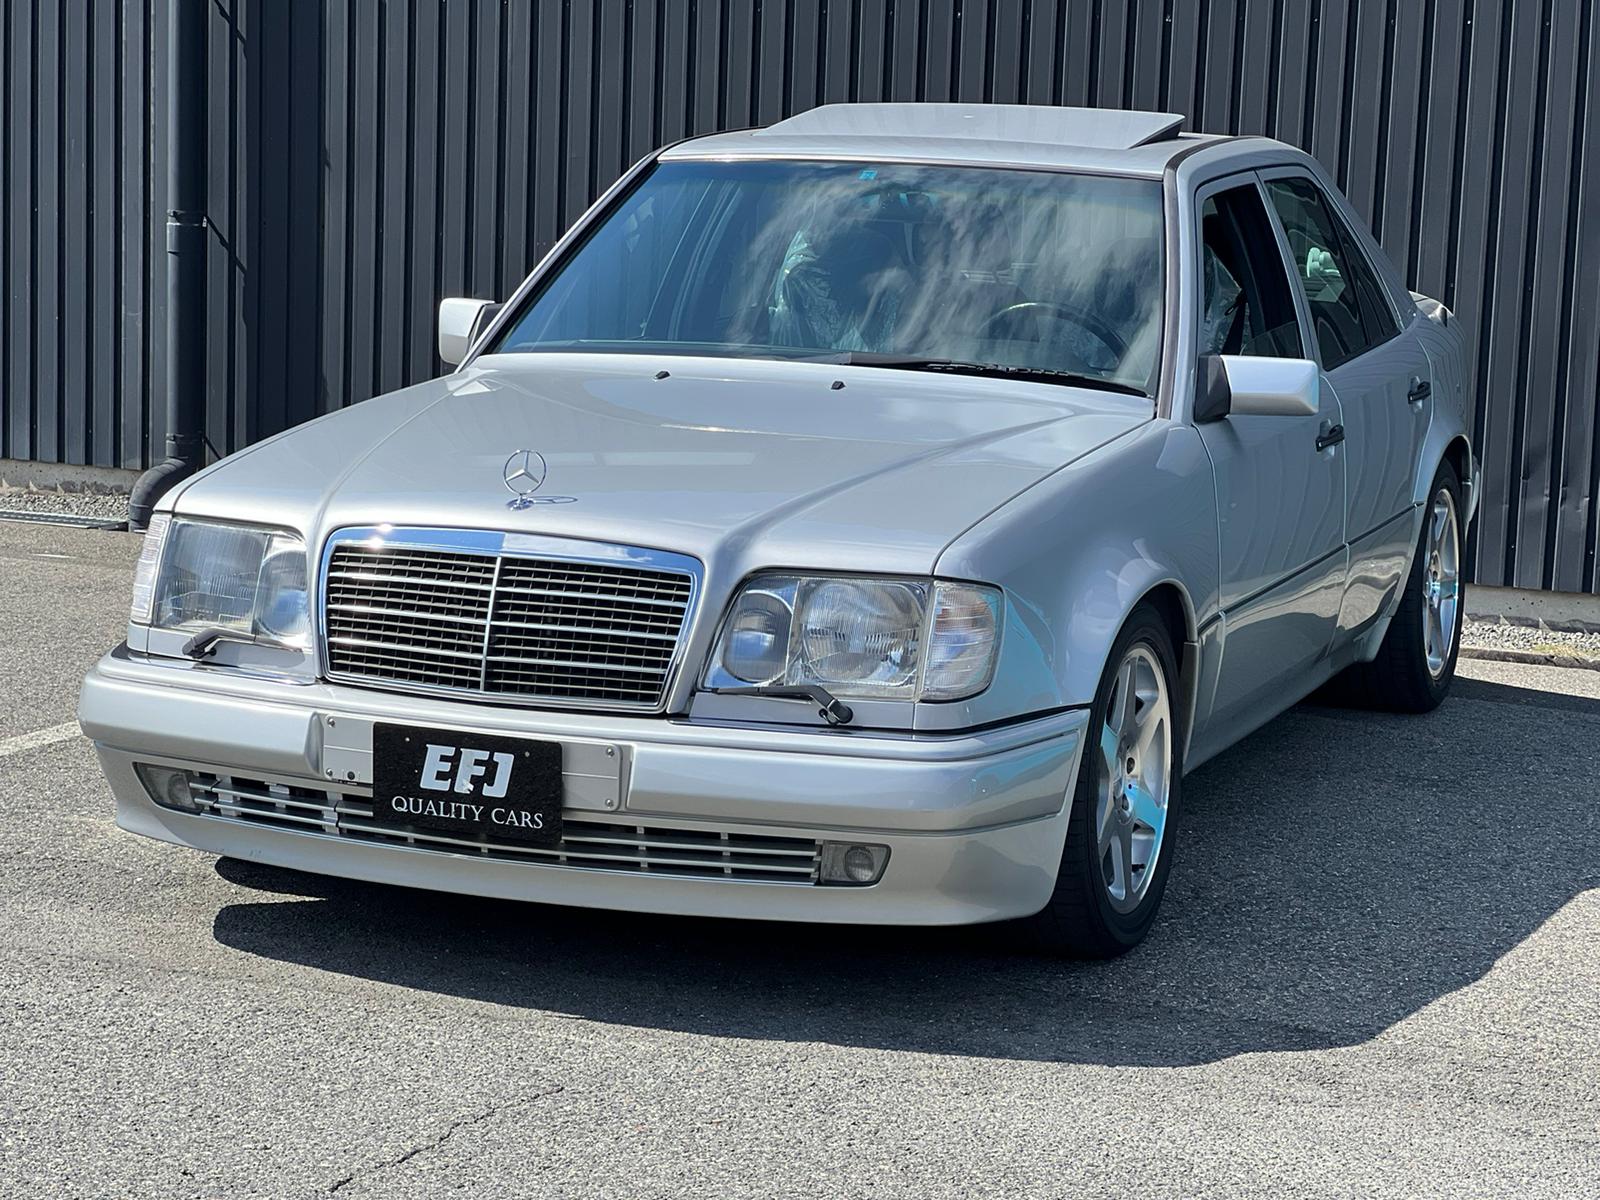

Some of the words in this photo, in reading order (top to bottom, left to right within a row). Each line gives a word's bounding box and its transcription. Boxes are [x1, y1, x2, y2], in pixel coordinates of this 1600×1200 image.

[420, 744, 514, 798] EFJ
[391, 796, 484, 821] QUALITY
[491, 808, 543, 829] CARS
